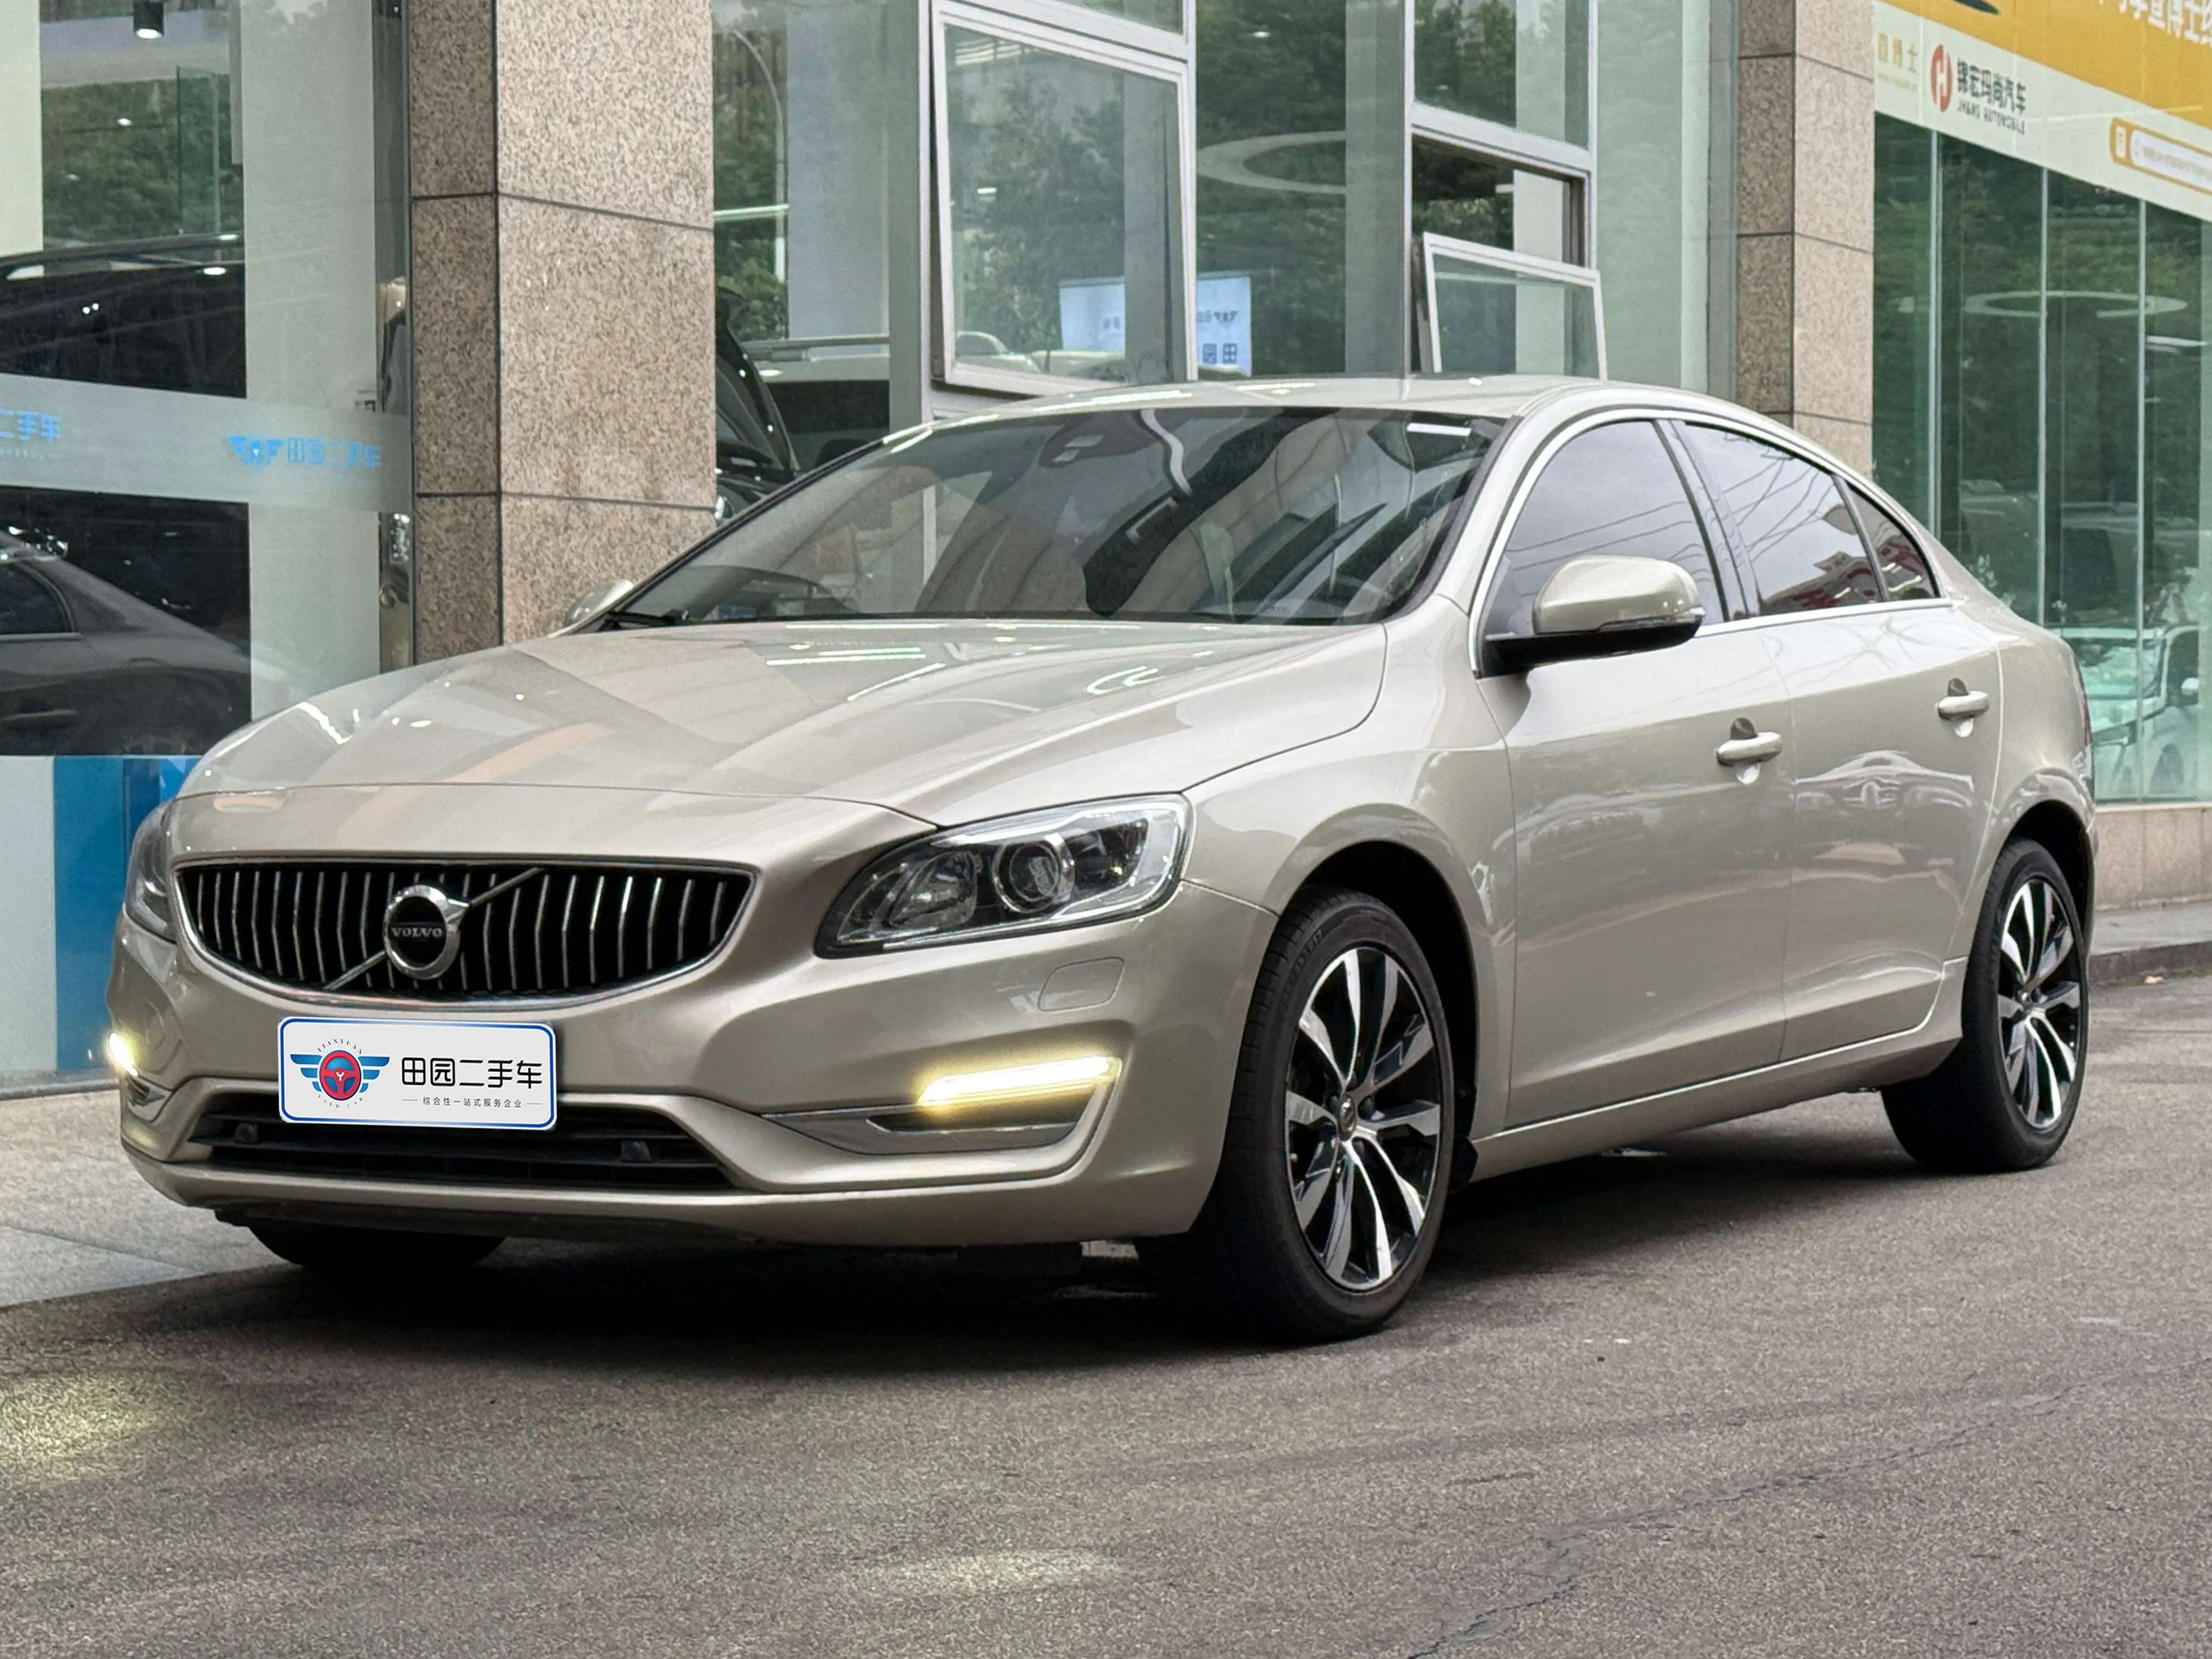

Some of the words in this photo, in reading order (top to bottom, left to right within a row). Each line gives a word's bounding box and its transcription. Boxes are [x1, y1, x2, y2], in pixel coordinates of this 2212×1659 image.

[391, 927, 443, 938] VOLVO
[401, 1057, 543, 1089] 田园二手车
[422, 1097, 522, 1108] 综合性一站式服务企业
